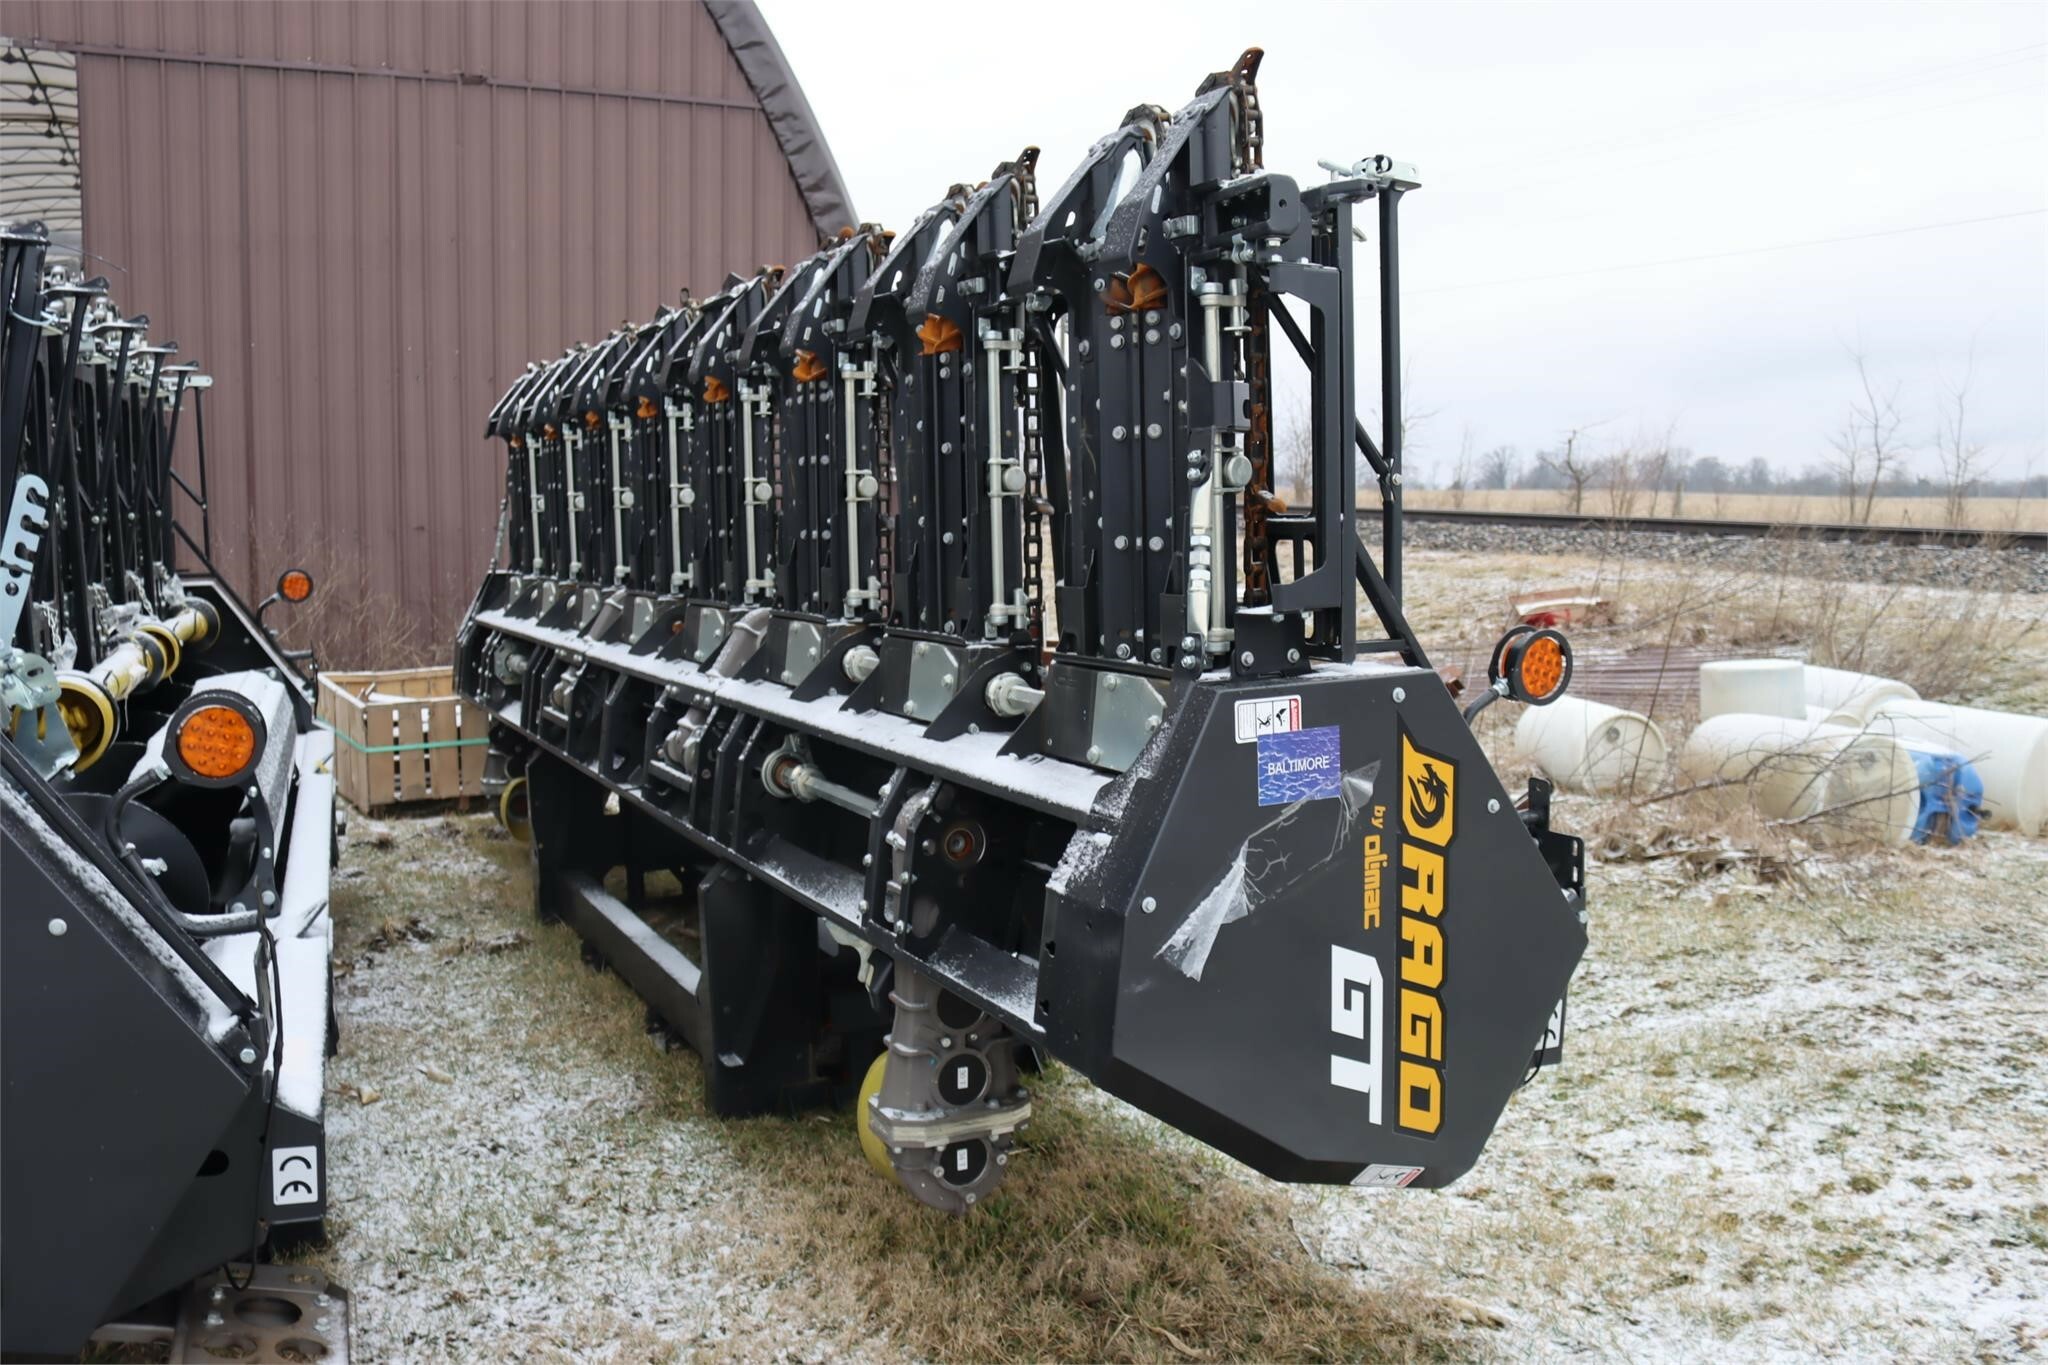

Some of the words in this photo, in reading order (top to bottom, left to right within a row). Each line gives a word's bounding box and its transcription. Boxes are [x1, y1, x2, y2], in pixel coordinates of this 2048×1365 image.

[1267, 755, 1330, 776] BALTIMORE
[1371, 805, 1386, 829] by
[1363, 834, 1388, 930] olimac
[1399, 733, 1454, 1134] DRAGO
[1331, 944, 1384, 1126] GT
